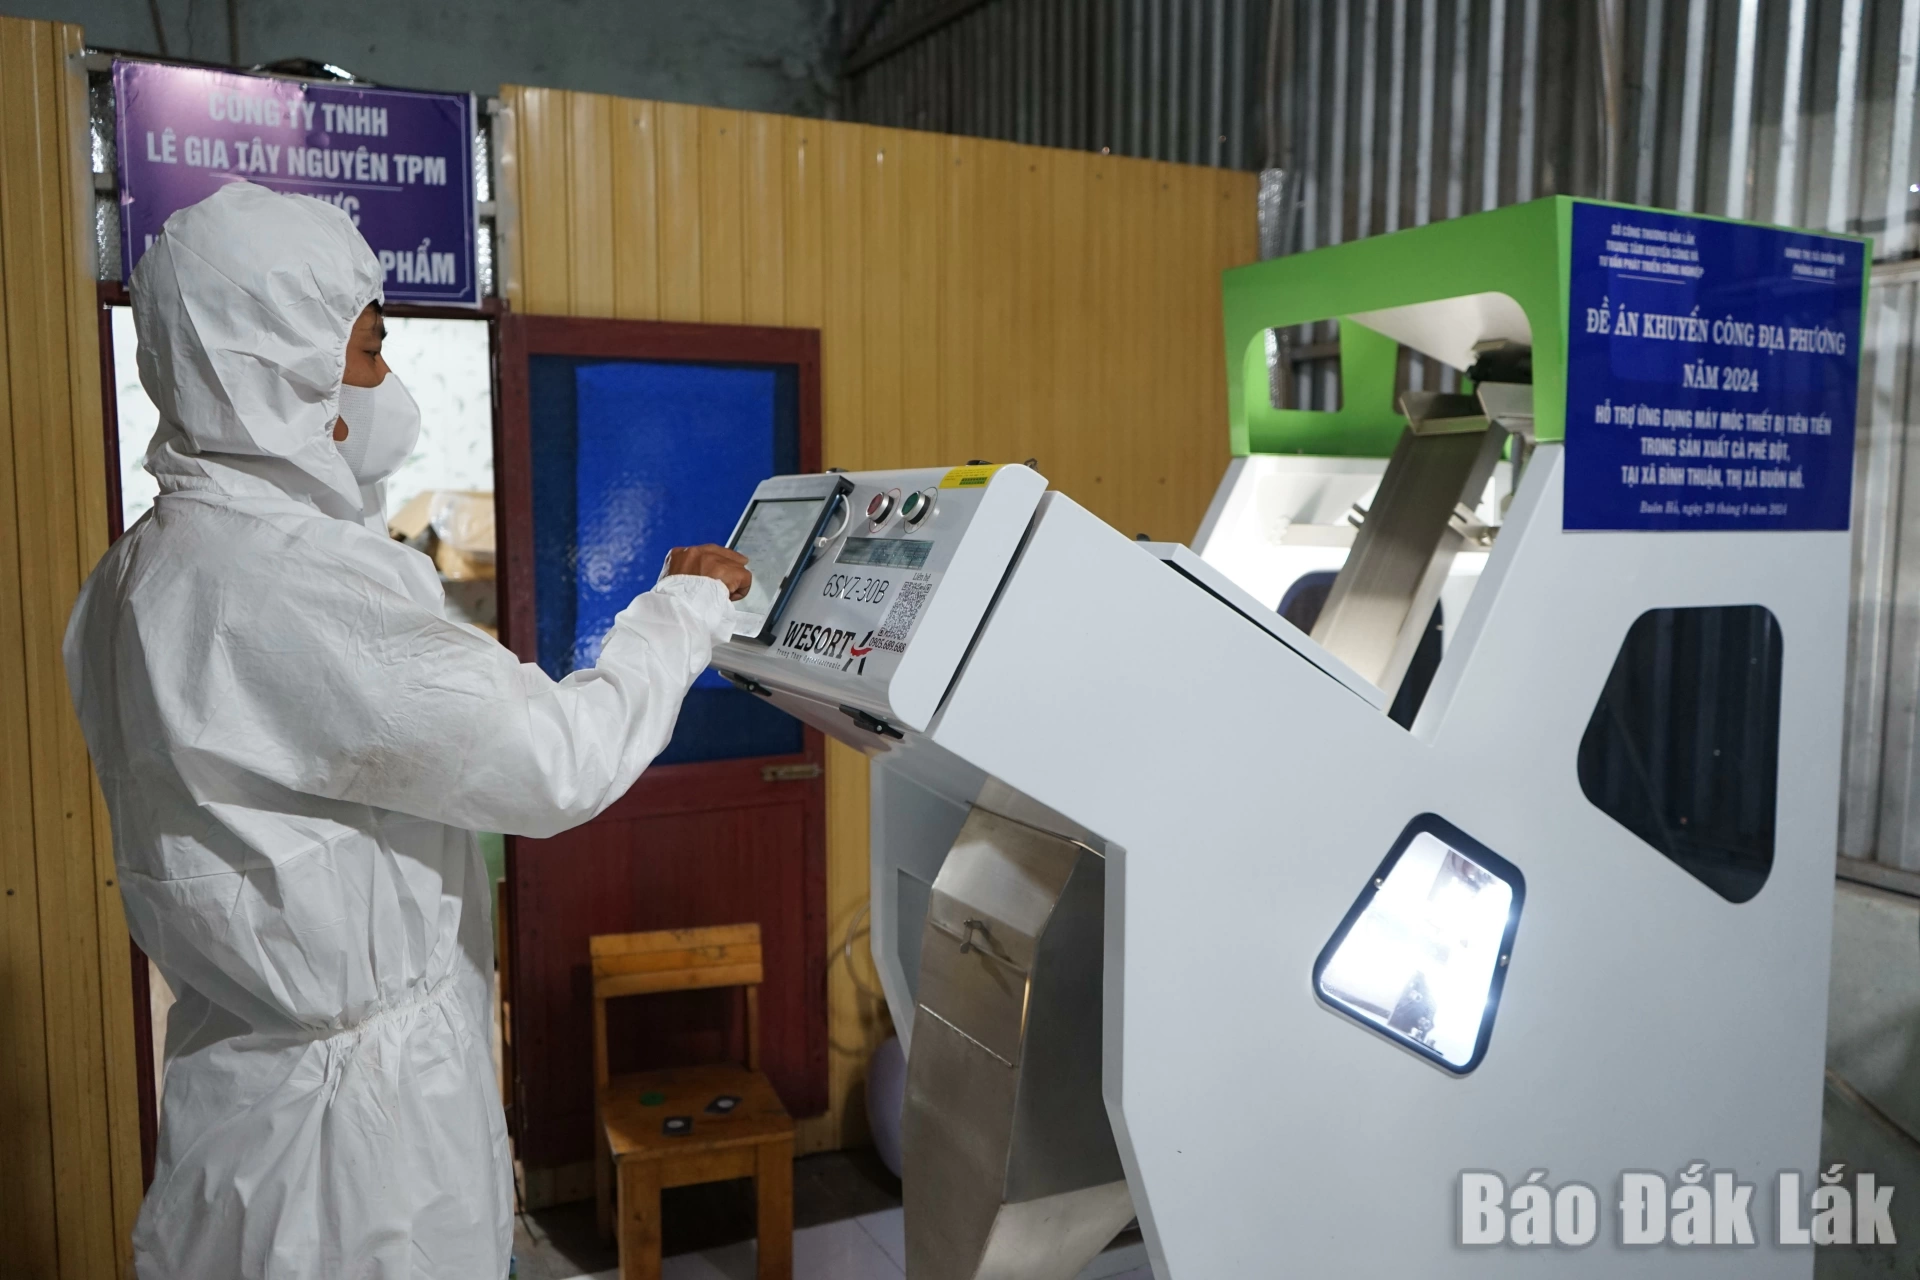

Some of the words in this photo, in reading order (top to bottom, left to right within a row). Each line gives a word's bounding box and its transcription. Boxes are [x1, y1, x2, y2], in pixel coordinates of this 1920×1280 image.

[209, 88, 280, 127] CÔNG
[287, 97, 316, 131] TY
[321, 103, 388, 137] TNHH
[147, 127, 177, 164] LÊ
[184, 135, 230, 170] GIA
[234, 136, 280, 174] TÂY
[287, 146, 388, 182] NGUYÊN
[393, 155, 447, 186] TPM
[378, 237, 456, 285] PHẨM
[1586, 295, 1611, 334] ĐỀ
[1613, 302, 1640, 337] ÁN
[1642, 304, 1710, 343] KHUYẾN
[1712, 314, 1755, 347] CÔNG
[1757, 324, 1785, 355] ĐỊA
[1788, 324, 1846, 356] PHƯƠNG
[1682, 358, 1719, 390] NĂM
[1722, 366, 1759, 393] 2024
[1594, 398, 1612, 424] HỖ
[1613, 403, 1636, 429] TRỢ
[1637, 403, 1661, 427] ỨNG
[1662, 408, 1693, 431] DỤNG
[1694, 406, 1719, 430] MÁY
[1720, 408, 1744, 432] MÓC
[1745, 408, 1773, 432] THIẾT
[1773, 415, 1785, 437] BỊ
[1787, 412, 1809, 435] TIÊN
[1810, 411, 1832, 436] TIẾN
[1640, 436, 1677, 457] TRONG
[1678, 432, 1701, 457] SẢN
[1702, 434, 1730, 458] XUẤT
[1731, 437, 1746, 459] CÀ
[1747, 438, 1767, 460] PHÊ
[1768, 439, 1791, 464] BỘT,
[1621, 465, 1640, 488] TẠI
[1641, 462, 1657, 485] XÃ
[1658, 462, 1685, 486] BÌNH
[1687, 464, 1724, 490] THUẬN,
[1726, 468, 1742, 491] THỊ
[1743, 465, 1758, 487] XÃ
[1759, 466, 1787, 488] BUÔN
[823, 573, 890, 604] 6SXZ-30B
[782, 620, 857, 659] WESORT
